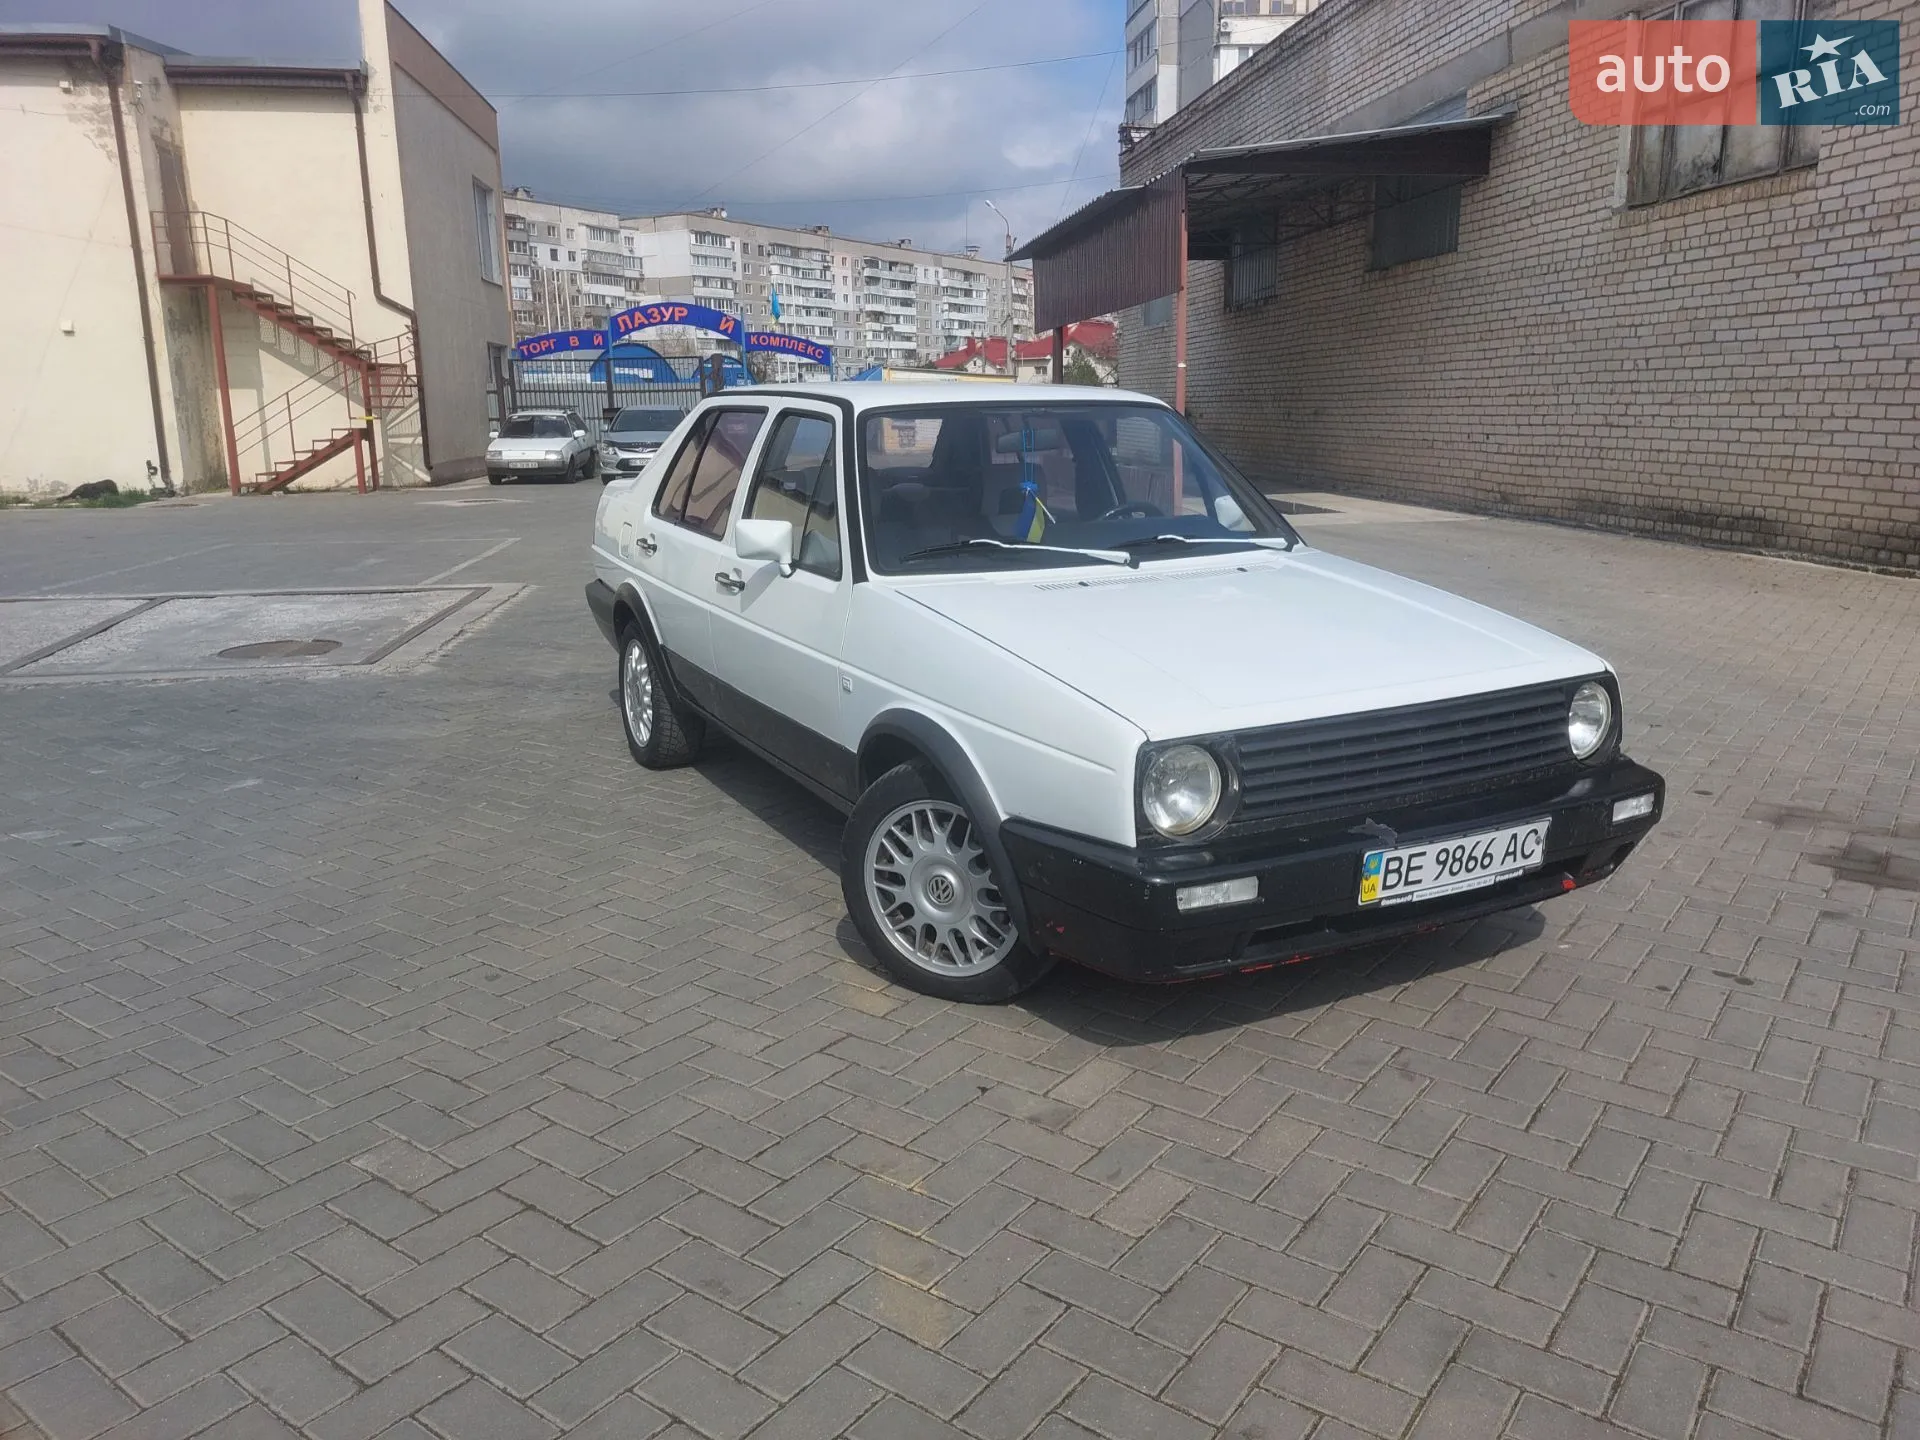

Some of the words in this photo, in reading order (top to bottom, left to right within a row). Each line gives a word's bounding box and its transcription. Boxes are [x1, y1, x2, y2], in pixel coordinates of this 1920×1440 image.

[750, 334, 824, 359] КОМПЛЕКС
[1381, 851, 1427, 891] BE
[1432, 837, 1497, 882] 9866
[1500, 828, 1539, 866] AC
[1363, 883, 1377, 895] UA
